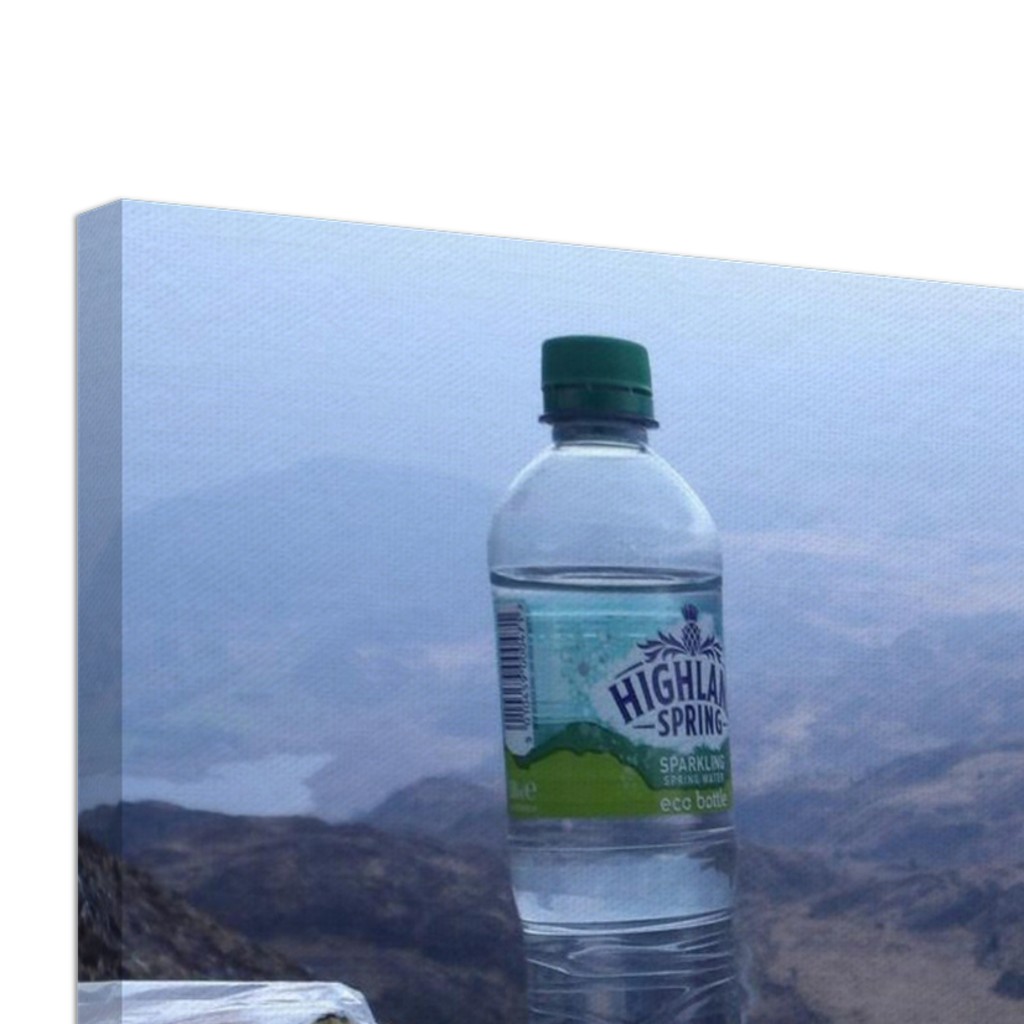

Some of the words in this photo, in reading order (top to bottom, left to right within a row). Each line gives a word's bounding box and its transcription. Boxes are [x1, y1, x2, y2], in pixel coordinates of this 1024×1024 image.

[658, 704, 723, 738] SPRING
[660, 754, 726, 773] SPARKLING
[663, 774, 700, 787] SPRING
[660, 796, 692, 812] eco
[695, 787, 728, 810] bottle
